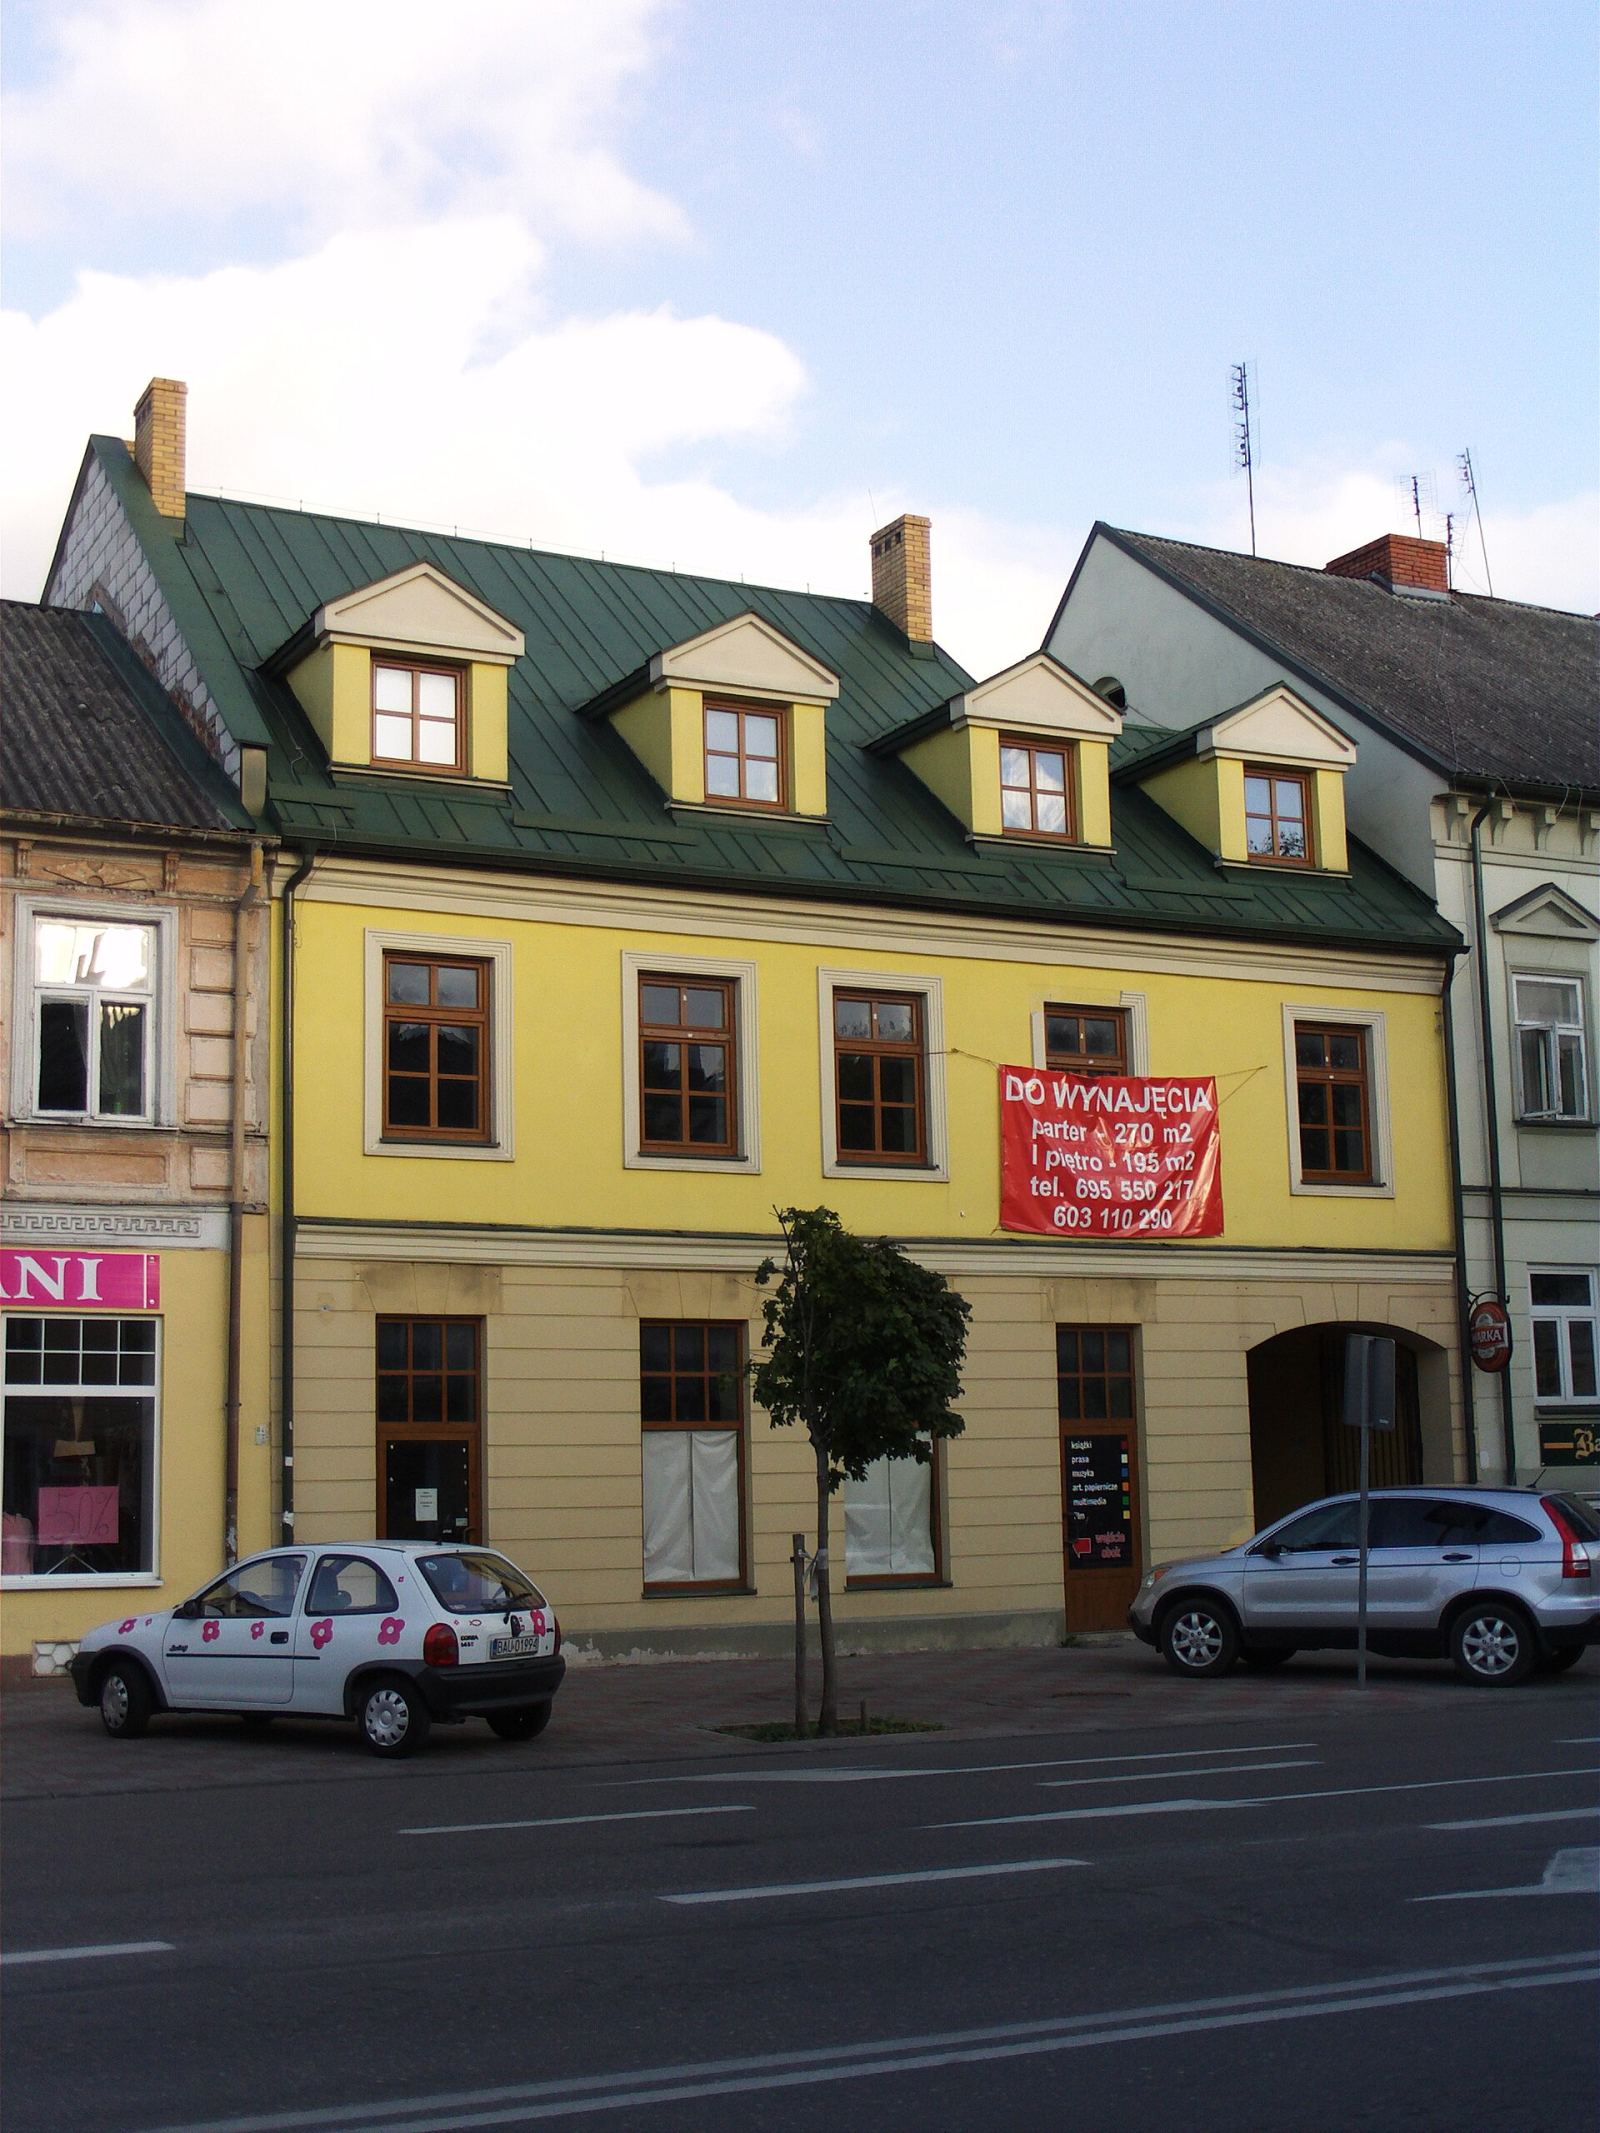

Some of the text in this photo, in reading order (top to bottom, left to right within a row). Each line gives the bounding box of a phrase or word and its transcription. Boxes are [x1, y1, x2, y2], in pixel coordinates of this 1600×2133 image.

[1006, 1075, 1212, 1119] DO WYNAJĘCIA
[1032, 1118, 1087, 1141] parter
[1115, 1123, 1153, 1144] 270
[1164, 1123, 1193, 1144] m2
[1046, 1148, 1102, 1173] piętro
[1122, 1152, 1159, 1173] 195
[1165, 1151, 1195, 1170] m2
[1030, 1176, 1194, 1200] tel. 695 550 217
[1053, 1205, 1172, 1230] 603 110 290
[0, 1255, 103, 1300] NI
[1072, 1456, 1090, 1465] prasa
[1072, 1469, 1094, 1478] muzyka
[1084, 1482, 1118, 1492] papiernicze
[45, 1490, 114, 1541] 50%
